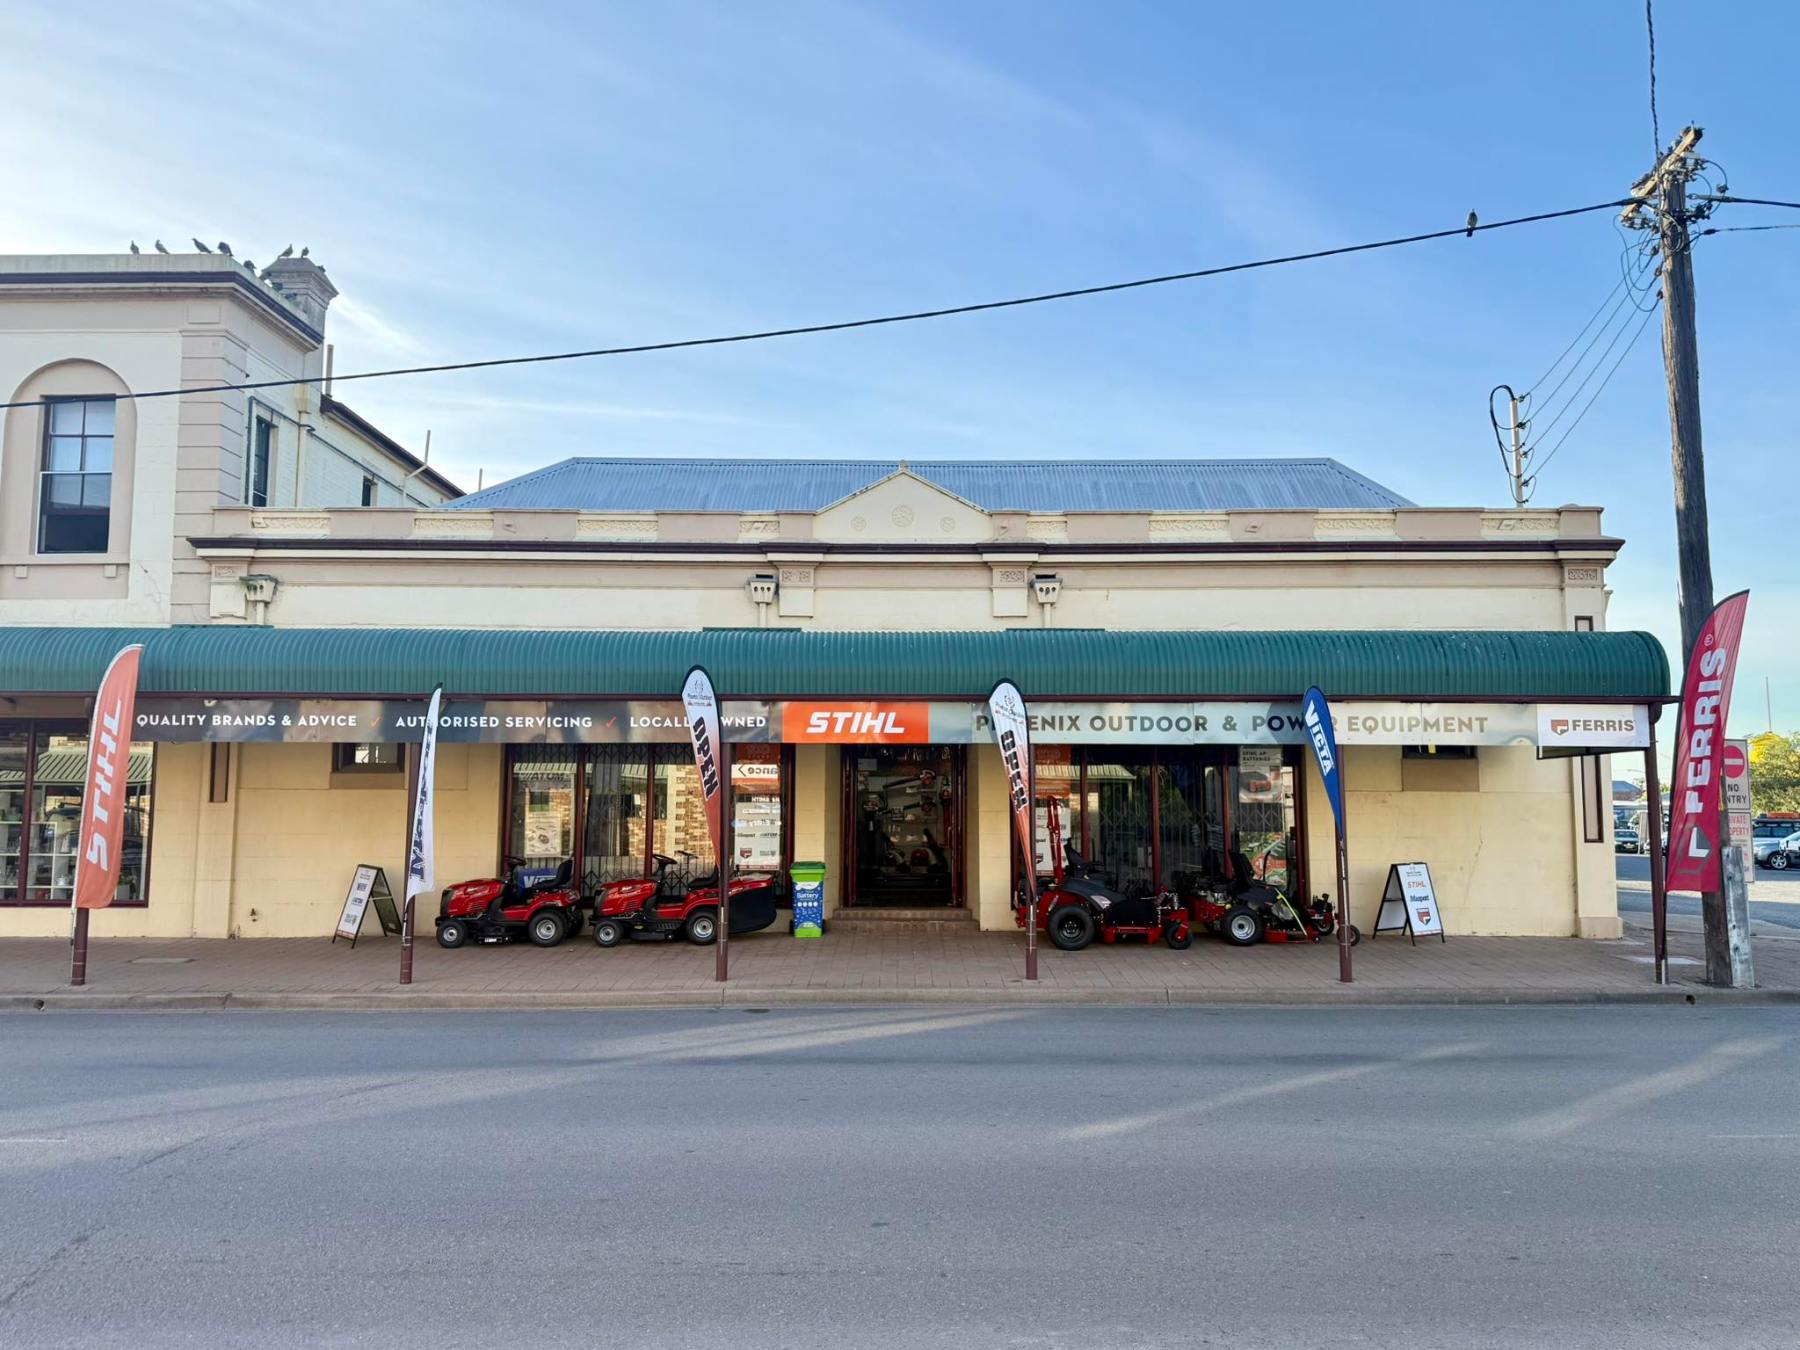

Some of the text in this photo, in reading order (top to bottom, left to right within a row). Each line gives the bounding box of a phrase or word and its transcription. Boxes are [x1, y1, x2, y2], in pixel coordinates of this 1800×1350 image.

[136, 714, 357, 727] QUALITY BRANDS & ADVICE
[395, 716, 593, 728] AUTORISED SERVICING
[630, 716, 766, 728] LOCALL WNED
[806, 711, 905, 734] STIHL
[976, 715, 1488, 734] PENIX OUTDOOR & POWR EQUIPMENT
[1572, 719, 1635, 732] FERRIS
[1684, 647, 1726, 814] FERRIS
[1305, 699, 1335, 776] VICTA
[693, 716, 719, 800] OPEN
[86, 698, 122, 872] STIHL
[1727, 783, 1739, 792] NO
[1727, 794, 1747, 804] NTRY
[1729, 815, 1746, 824] IVATE
[1407, 881, 1426, 889] STIHL
